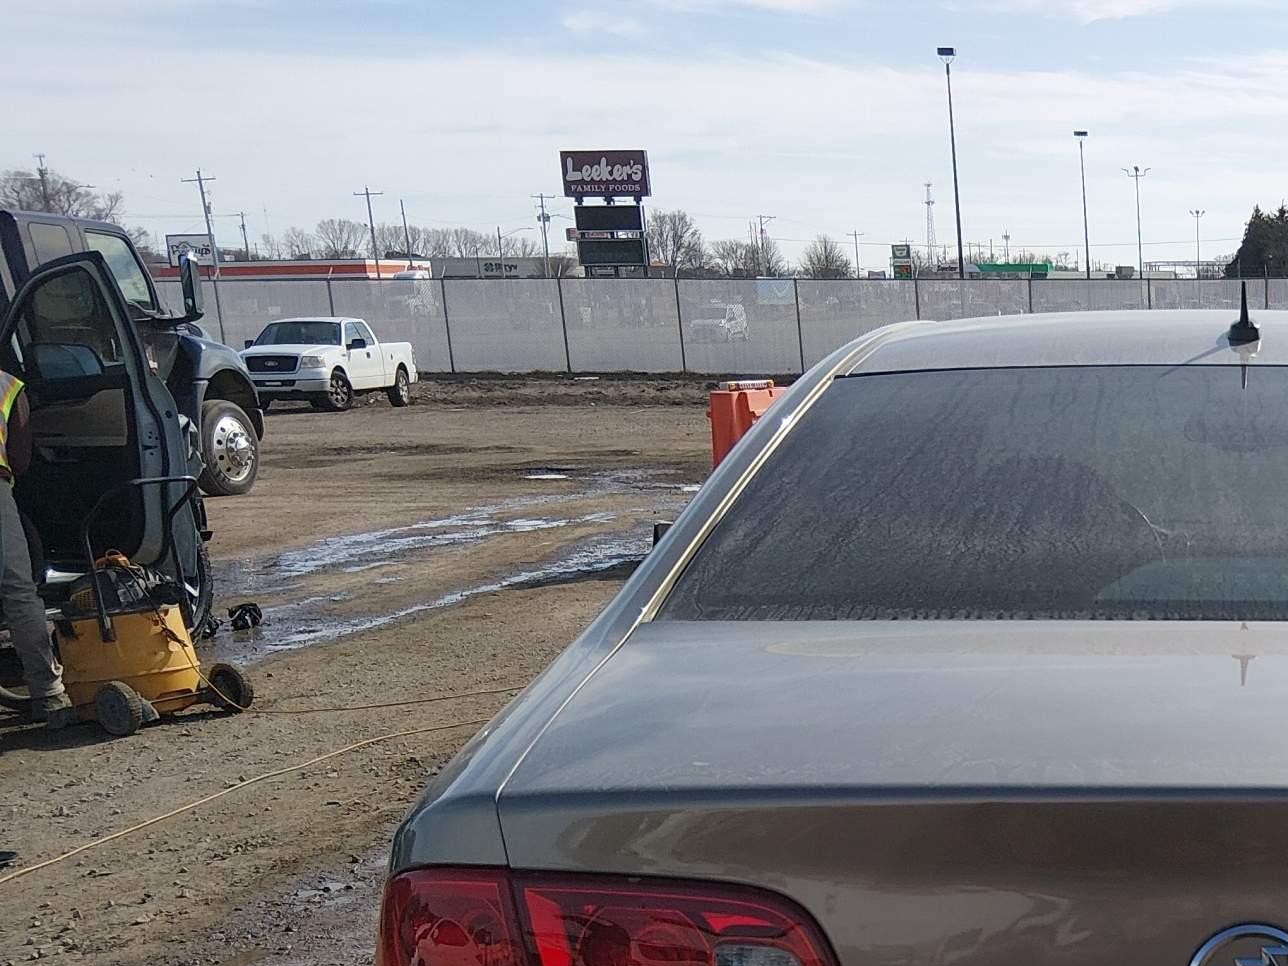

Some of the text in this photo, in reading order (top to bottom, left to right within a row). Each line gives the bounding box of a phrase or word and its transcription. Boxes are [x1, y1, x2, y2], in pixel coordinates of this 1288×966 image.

[566, 157, 643, 181] Leeker's
[571, 184, 641, 192] FAMILY FOODS
